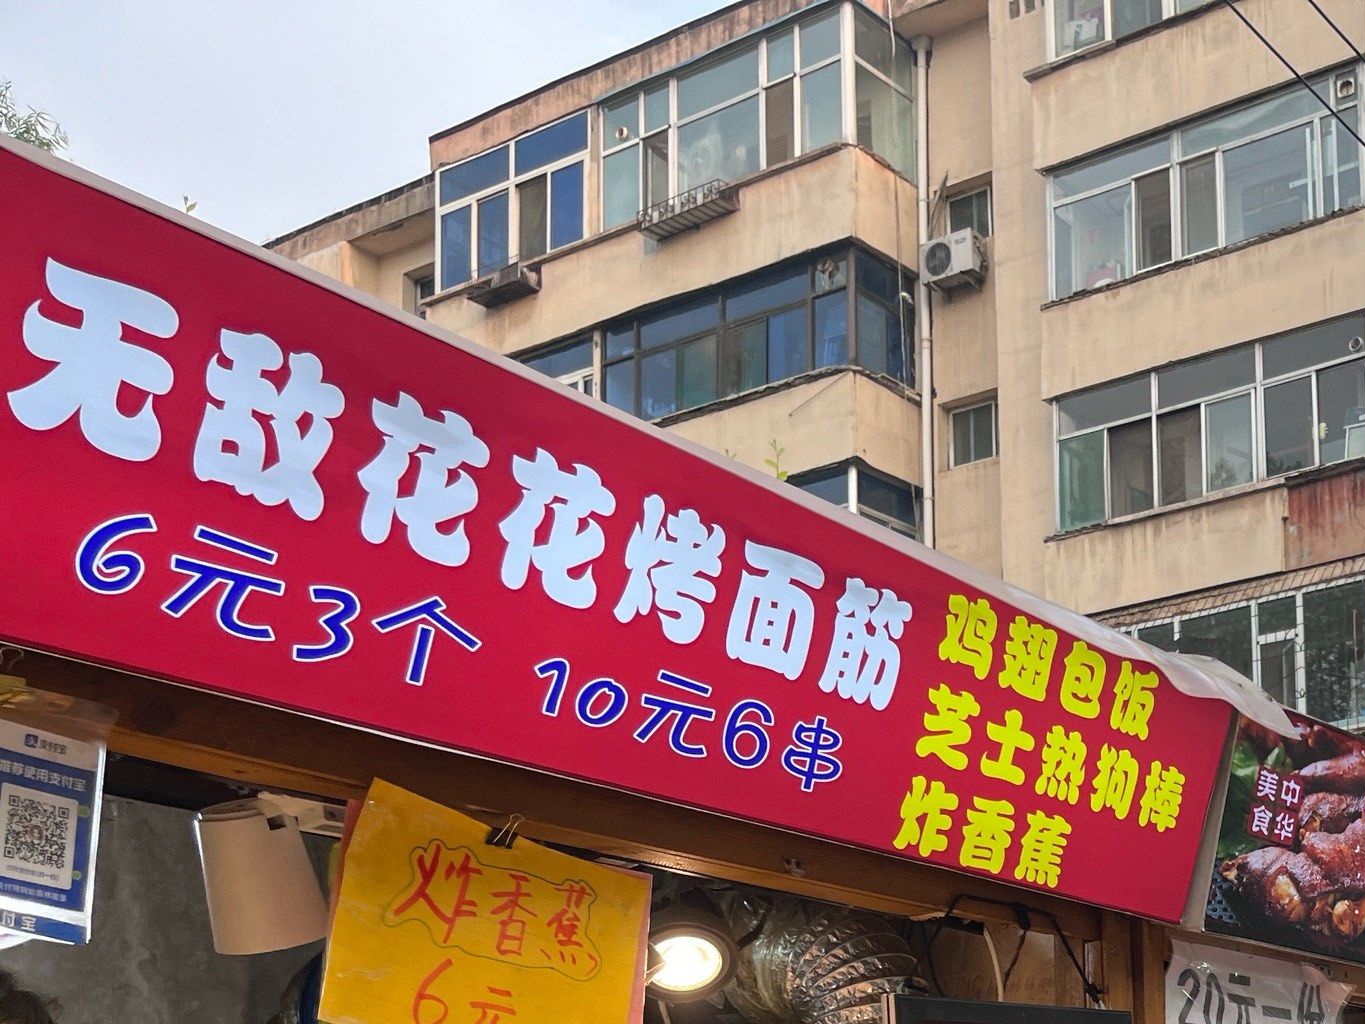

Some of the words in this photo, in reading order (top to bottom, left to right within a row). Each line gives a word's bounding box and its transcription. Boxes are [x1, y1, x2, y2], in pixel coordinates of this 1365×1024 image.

[7, 257, 912, 711] 无敌花花烤面筋
[75, 514, 482, 687] 6元3个
[535, 657, 842, 793] 10元6串
[938, 594, 1160, 740] 鸡翅包饭
[893, 775, 1072, 888] 炸香蕉
[916, 684, 1186, 832] 芝士热狗棒
[395, 840, 598, 976] 炸香蕉
